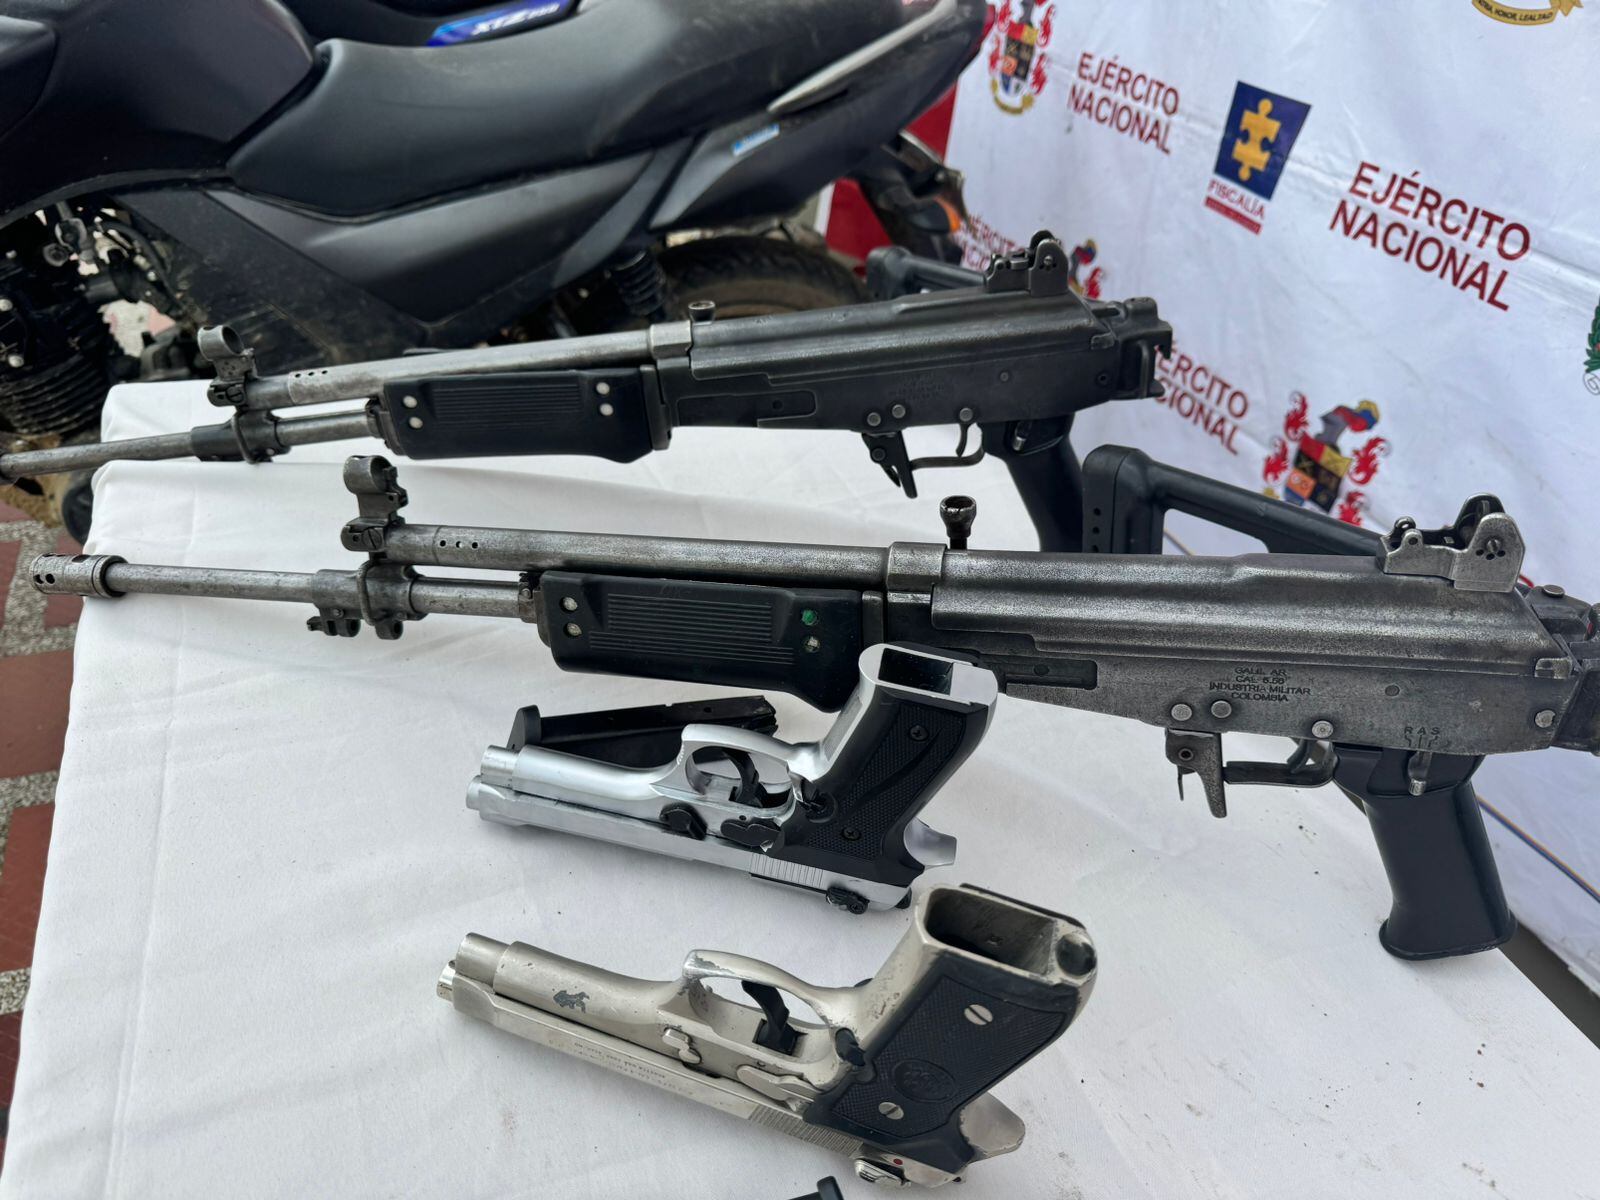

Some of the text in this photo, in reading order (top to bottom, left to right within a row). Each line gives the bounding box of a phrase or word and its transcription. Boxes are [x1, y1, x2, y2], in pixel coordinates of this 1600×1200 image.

[1078, 52, 1180, 117] EJÉRCITO
[1066, 83, 1171, 156] NACIONAL
[1348, 160, 1531, 261] EJÉRCITO
[1328, 198, 1510, 313] NACIONAL
[1209, 681, 1312, 696] INDUSTRIA MILITAR
[1230, 691, 1290, 702] COLOMBIA
